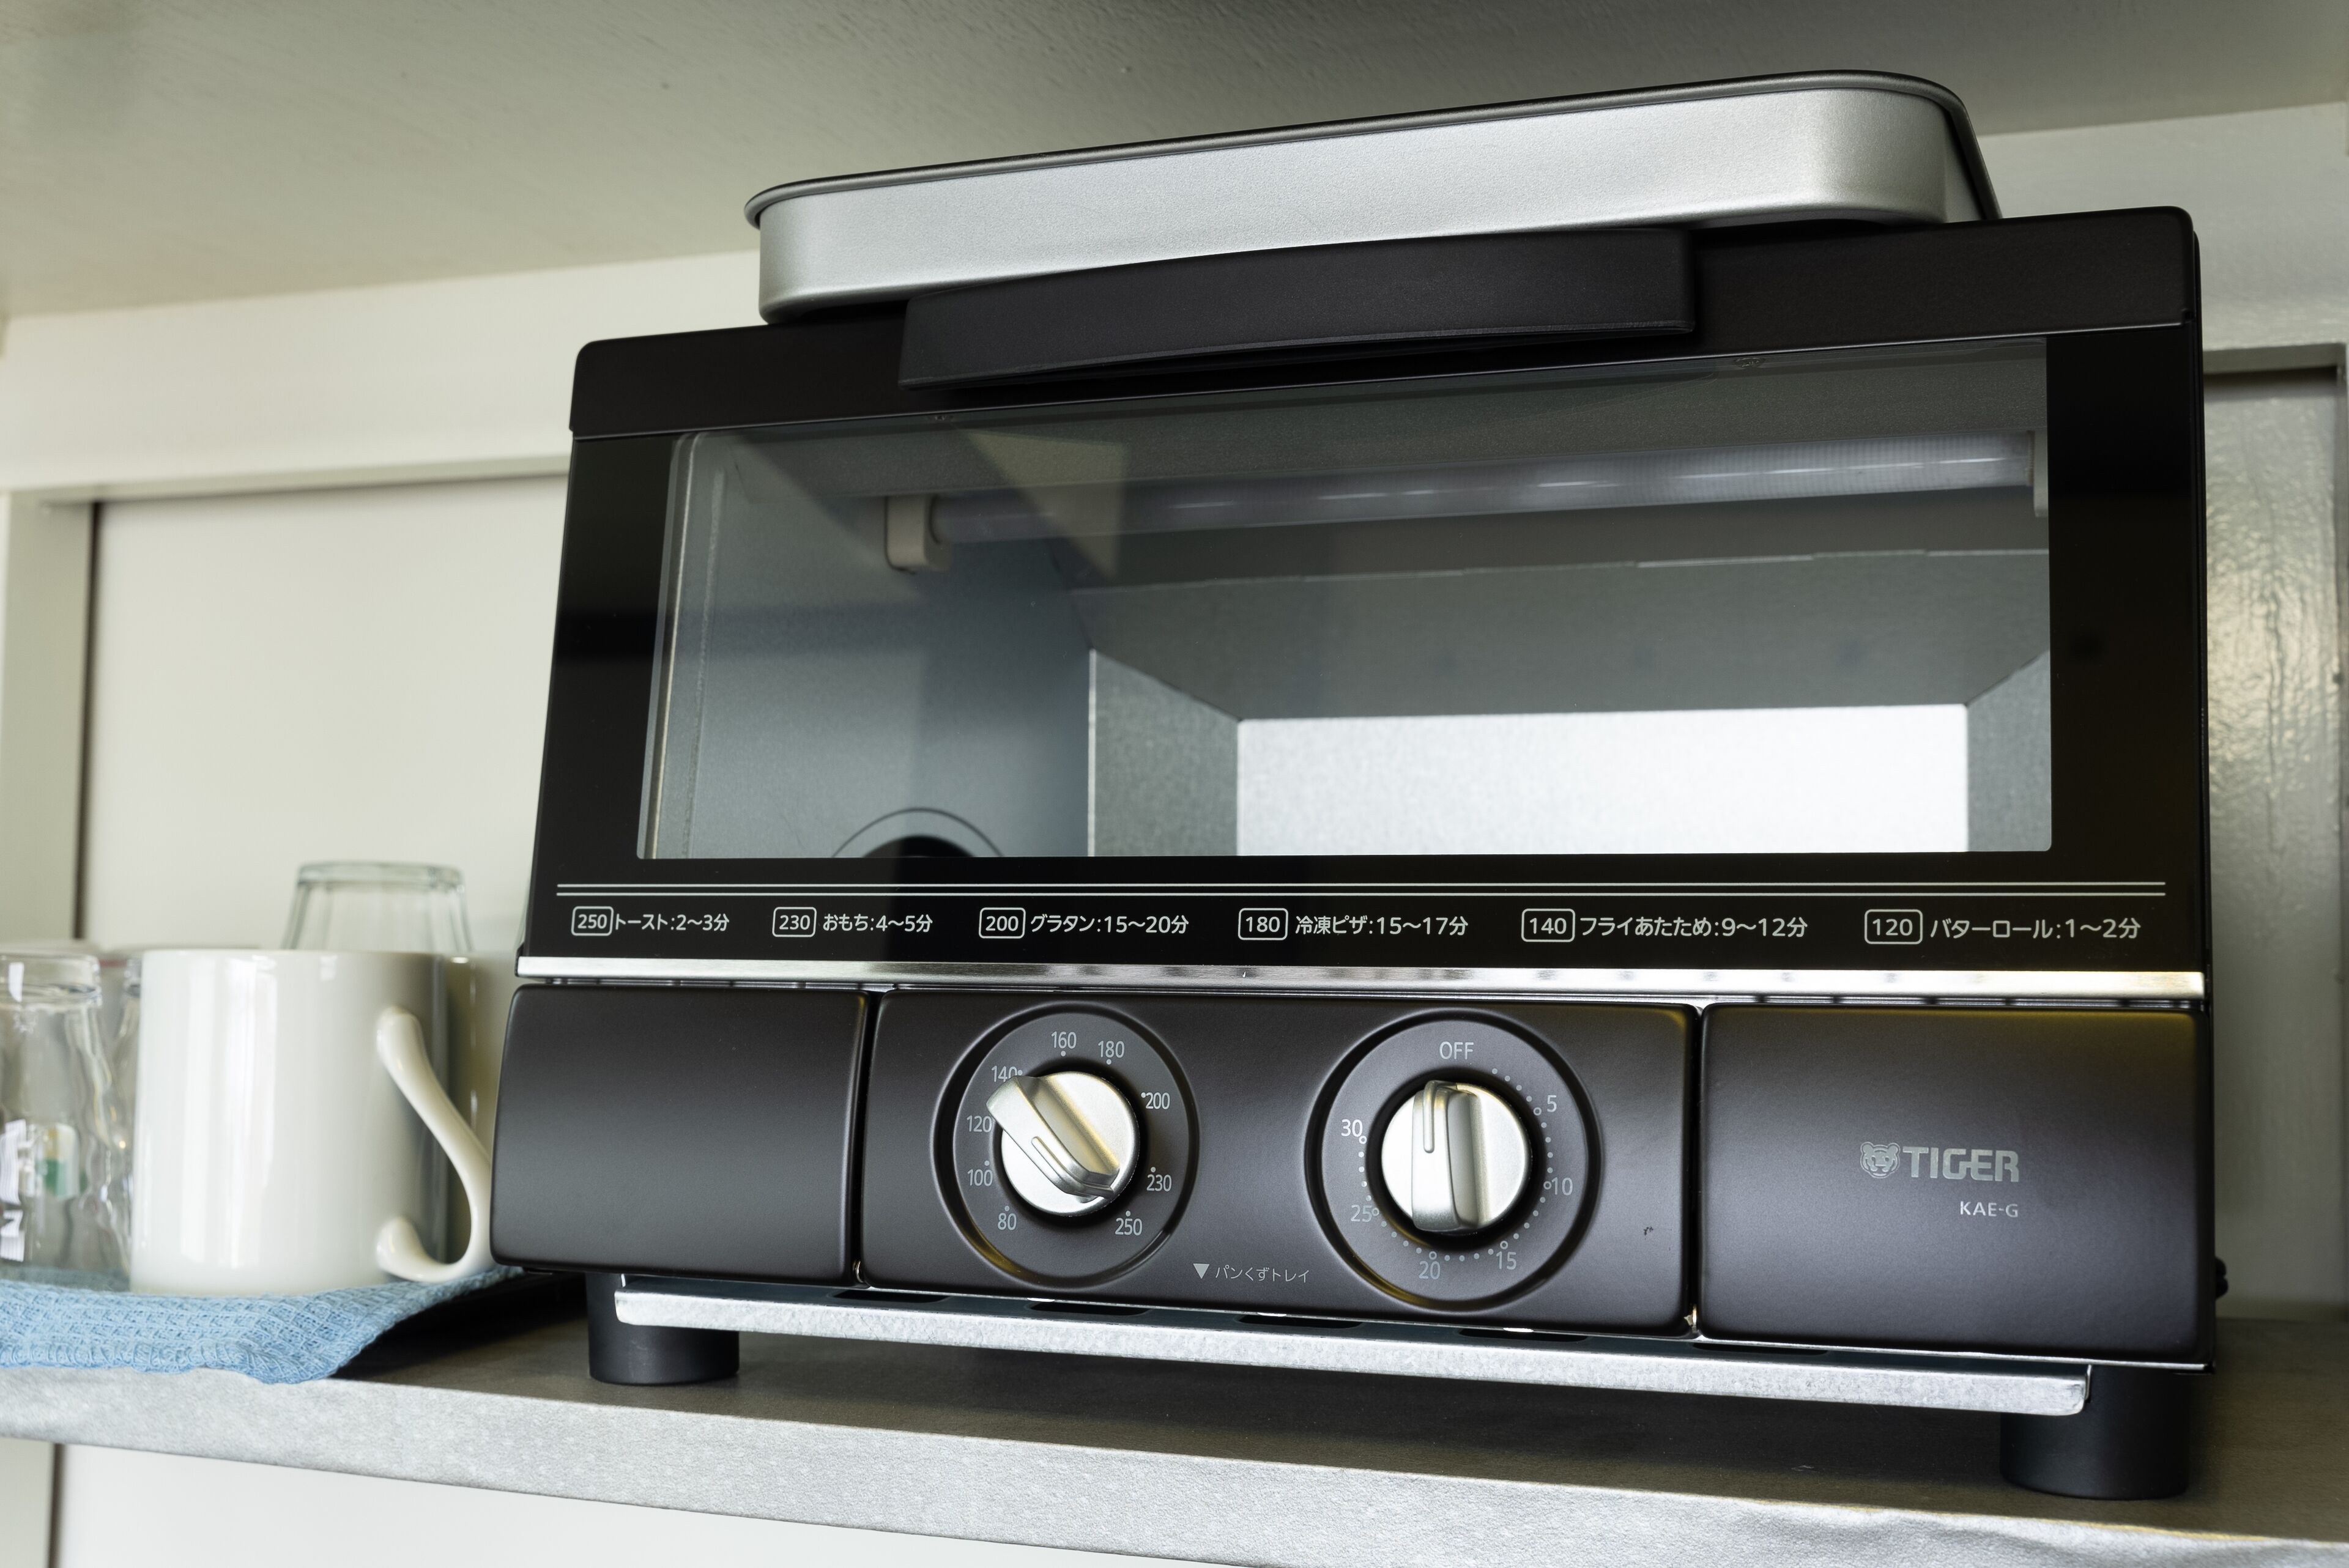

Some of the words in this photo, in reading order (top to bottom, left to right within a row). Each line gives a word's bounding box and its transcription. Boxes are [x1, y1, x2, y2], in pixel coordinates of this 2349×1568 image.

[577, 914, 607, 929] 250
[779, 915, 811, 930] 230
[985, 915, 1019, 931] 200
[1245, 916, 1280, 933] 180
[1529, 917, 1567, 934] 140
[1872, 919, 1913, 936] 120
[1051, 1031, 1077, 1049] 160
[1097, 1040, 1125, 1059] 180
[1439, 1041, 1475, 1060] OFF
[1145, 1092, 1171, 1110] 200
[1546, 1095, 1557, 1112] 5
[966, 1115, 992, 1133] 120
[1340, 1119, 1363, 1137] 30
[1902, 1145, 2020, 1183] TIGER
[967, 1168, 993, 1186] 100
[1146, 1174, 1172, 1192] 230
[1551, 1177, 1573, 1196] 10
[1350, 1205, 1373, 1222] 25
[1959, 1200, 2019, 1218] KAE-G
[997, 1213, 1017, 1230] 80
[1115, 1218, 1143, 1236] 250
[1496, 1251, 1517, 1270] 15
[1215, 1264, 1310, 1284] パンくずトレイ
[1418, 1260, 1441, 1280] 20
